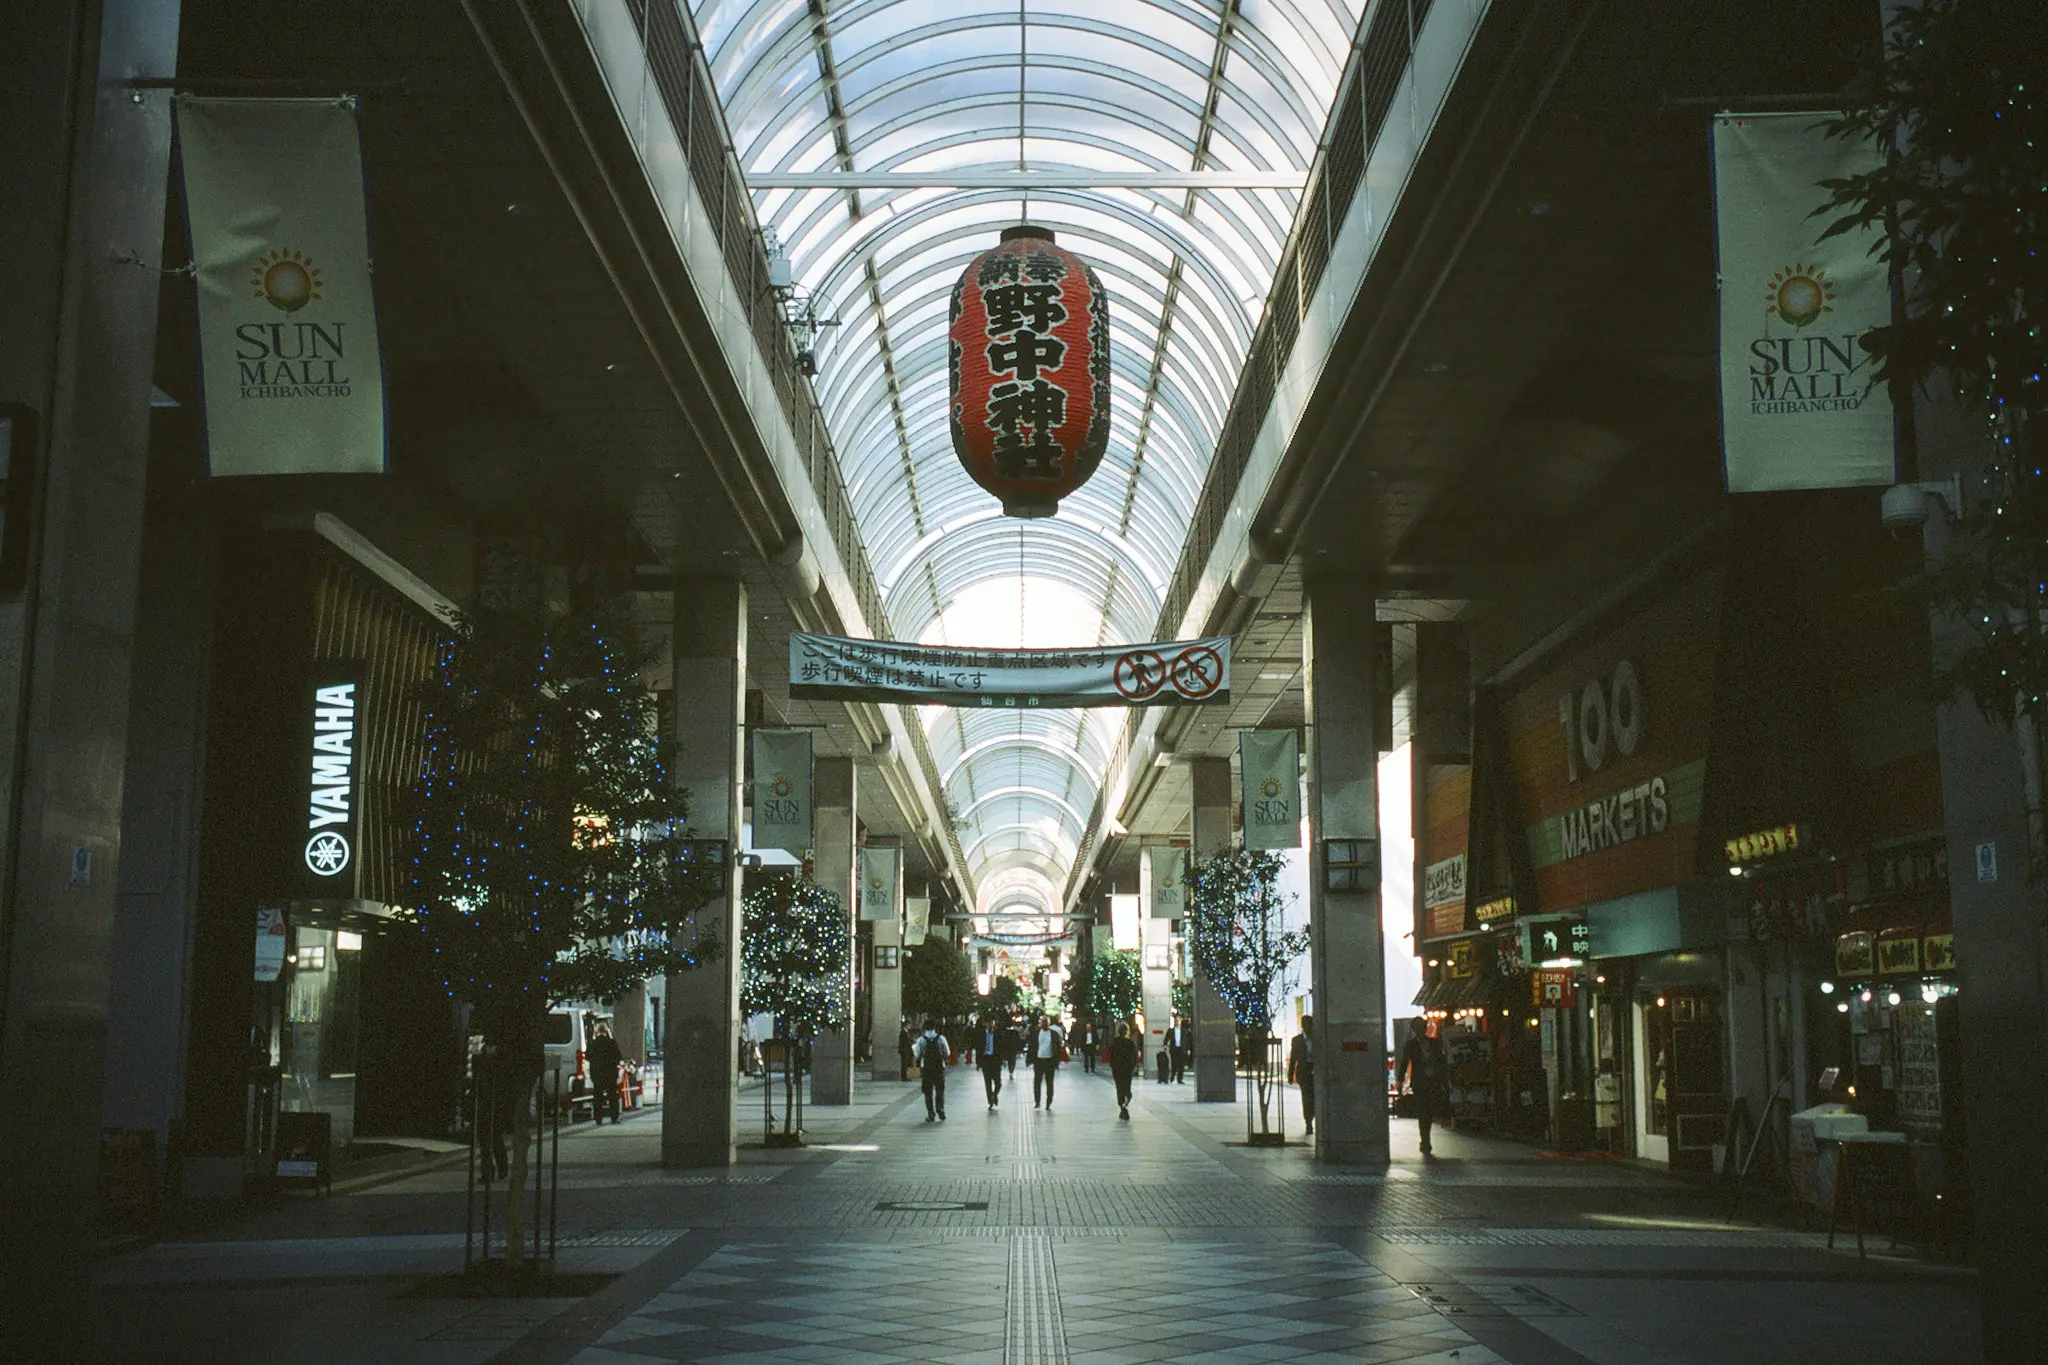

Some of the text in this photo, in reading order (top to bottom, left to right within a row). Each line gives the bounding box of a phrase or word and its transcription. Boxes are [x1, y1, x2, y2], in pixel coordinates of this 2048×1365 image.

[235, 322, 347, 360] SUN
[1750, 334, 1857, 375] SUN
[238, 360, 350, 386] MALL
[239, 385, 351, 399] ICHIBANCHO
[1750, 373, 1858, 401] MALL
[1751, 399, 1860, 415] ICHIBANCHO
[801, 662, 988, 690] 歩行喫煙は禁止です
[1558, 660, 1642, 784] 100
[309, 683, 356, 830] YAMAHA
[764, 799, 800, 812] SUN
[764, 811, 799, 821] MALL
[1254, 799, 1289, 813] SUN
[1254, 812, 1288, 822] MALL
[1560, 777, 1669, 861] MARKETS
[1571, 924, 1588, 938] 中
